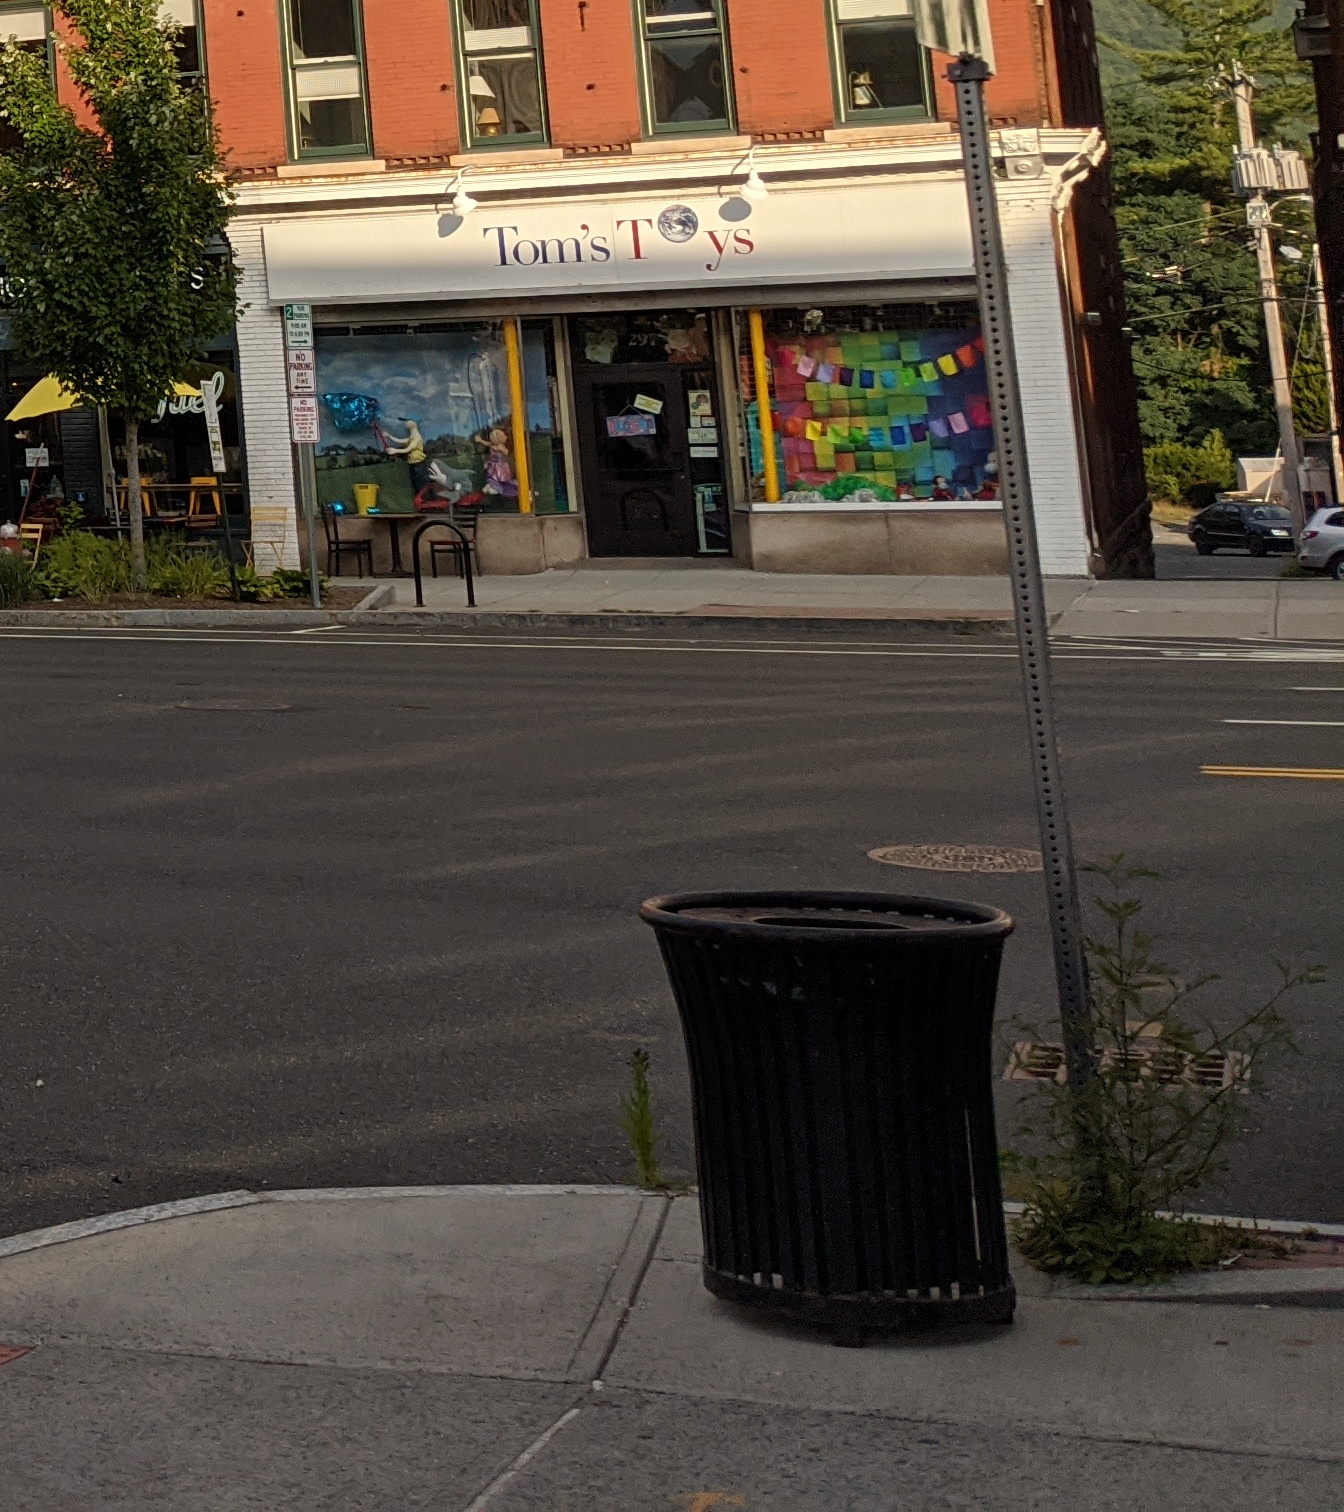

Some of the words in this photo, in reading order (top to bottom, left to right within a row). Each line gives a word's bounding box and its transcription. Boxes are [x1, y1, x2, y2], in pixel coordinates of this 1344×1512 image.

[482, 223, 611, 267] Tom's
[285, 306, 293, 318] 2
[295, 353, 306, 361] NO
